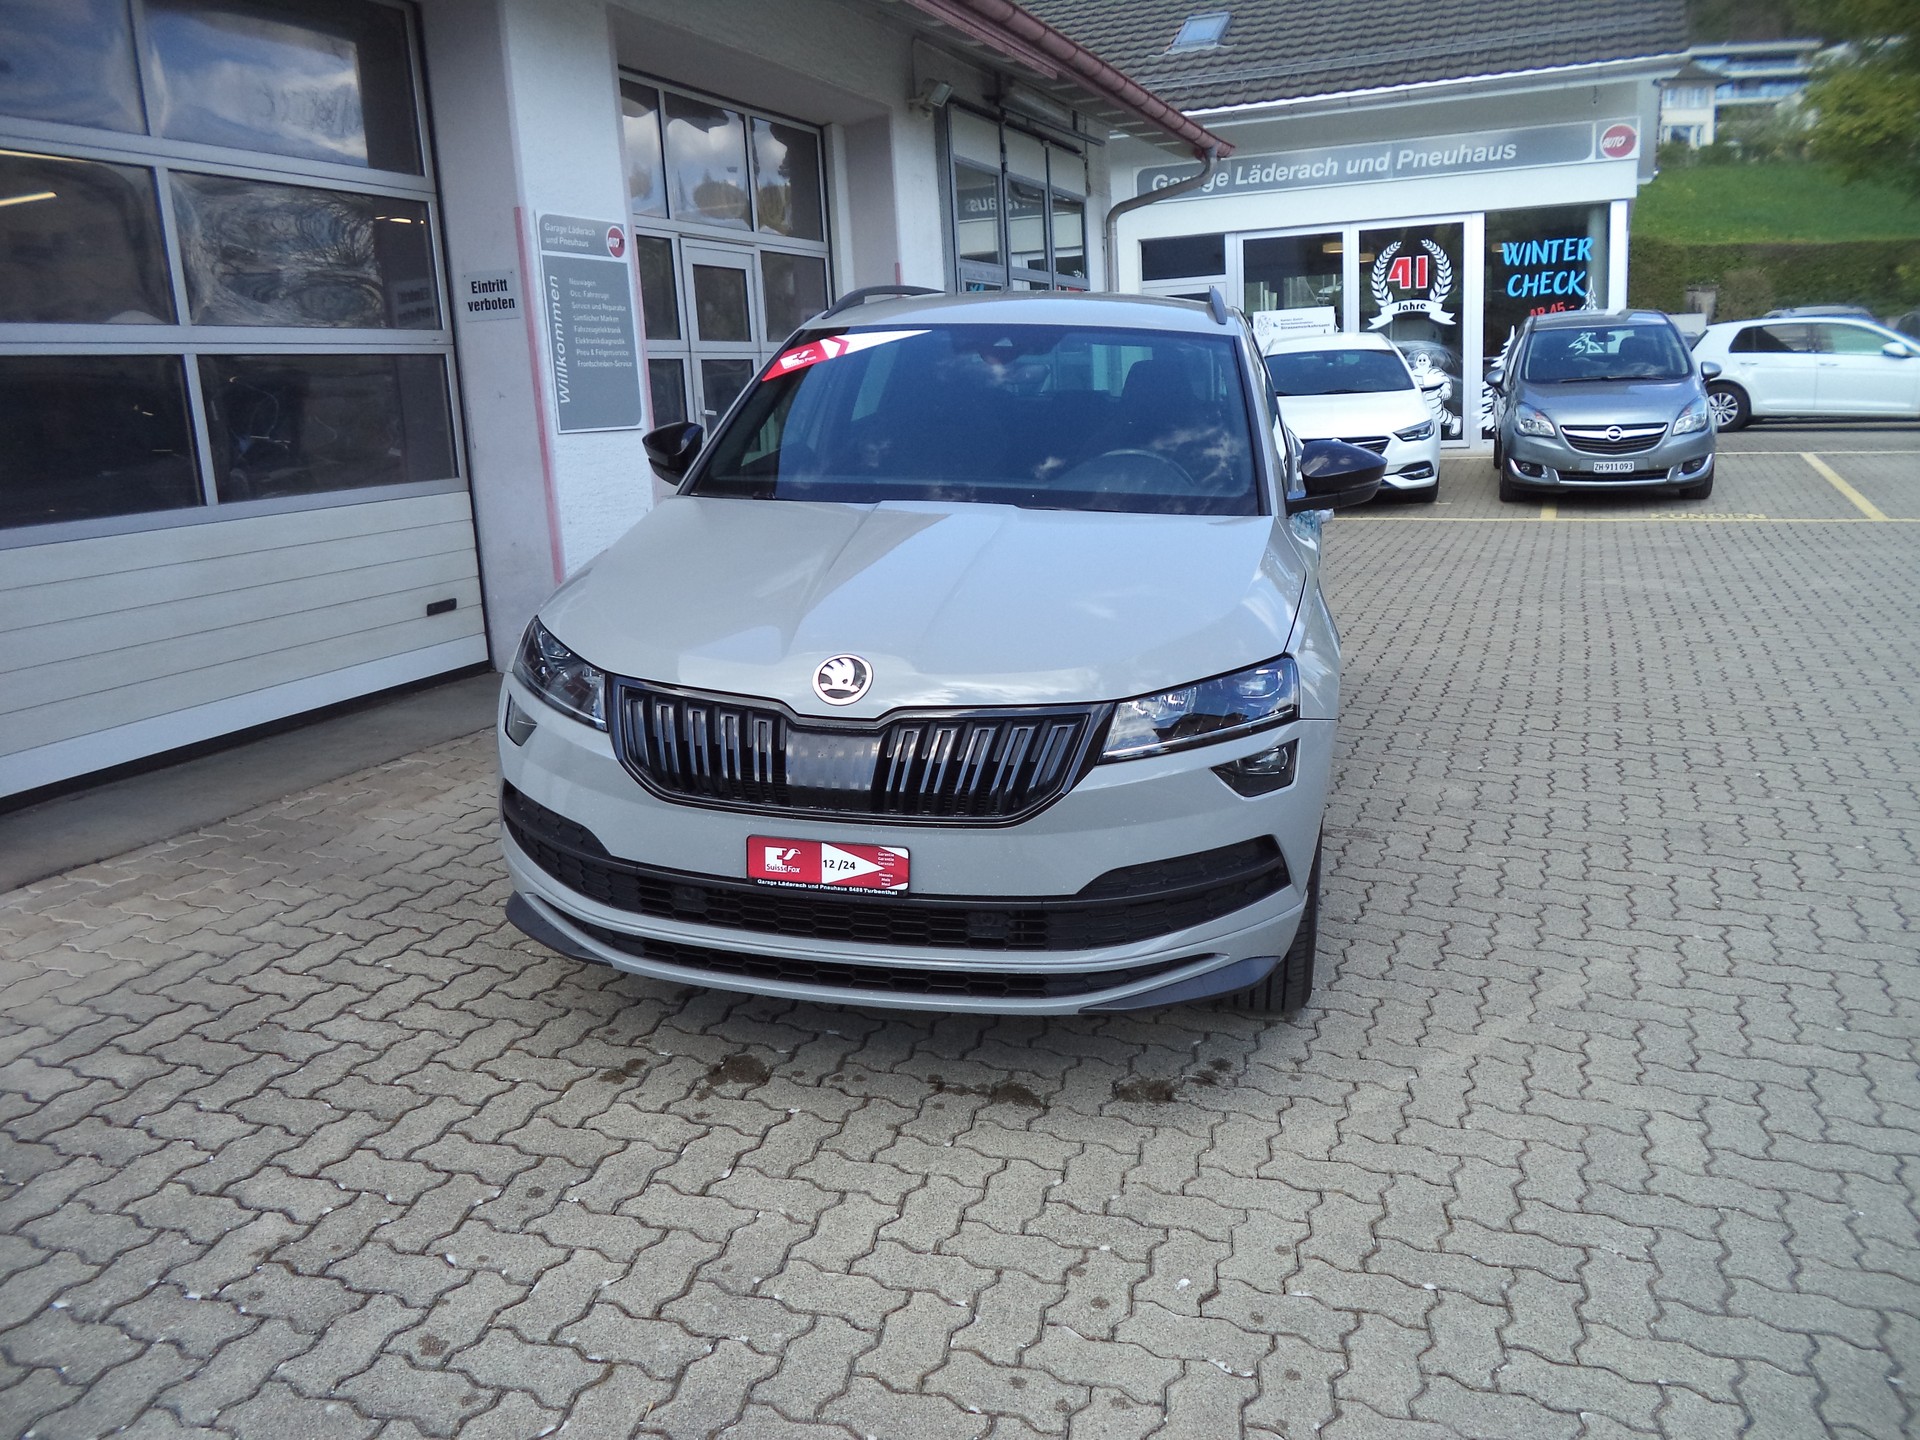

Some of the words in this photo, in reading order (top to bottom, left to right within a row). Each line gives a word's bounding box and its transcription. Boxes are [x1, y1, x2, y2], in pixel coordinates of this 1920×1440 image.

[1235, 157, 1338, 186] Läderach
[1345, 151, 1391, 174] und
[1397, 142, 1517, 170] Pneuhaus
[544, 222, 567, 234] Garage
[568, 225, 596, 237] Läderach
[546, 237, 558, 245] und
[559, 237, 589, 248] Pneuhaus
[1502, 236, 1594, 267] WINTER
[1386, 255, 1429, 290] 41
[470, 279, 508, 294] Eintritt
[1506, 270, 1587, 298] CHECK
[467, 297, 515, 312] verboten
[1398, 302, 1427, 312] Jahre
[549, 275, 571, 404] Willkommen
[823, 859, 835, 869] 12
[757, 878, 777, 886] Garage
[777, 880, 807, 888] Läderach
[820, 884, 847, 892] Pneuhaus
[863, 888, 898, 896] Turbenthal
